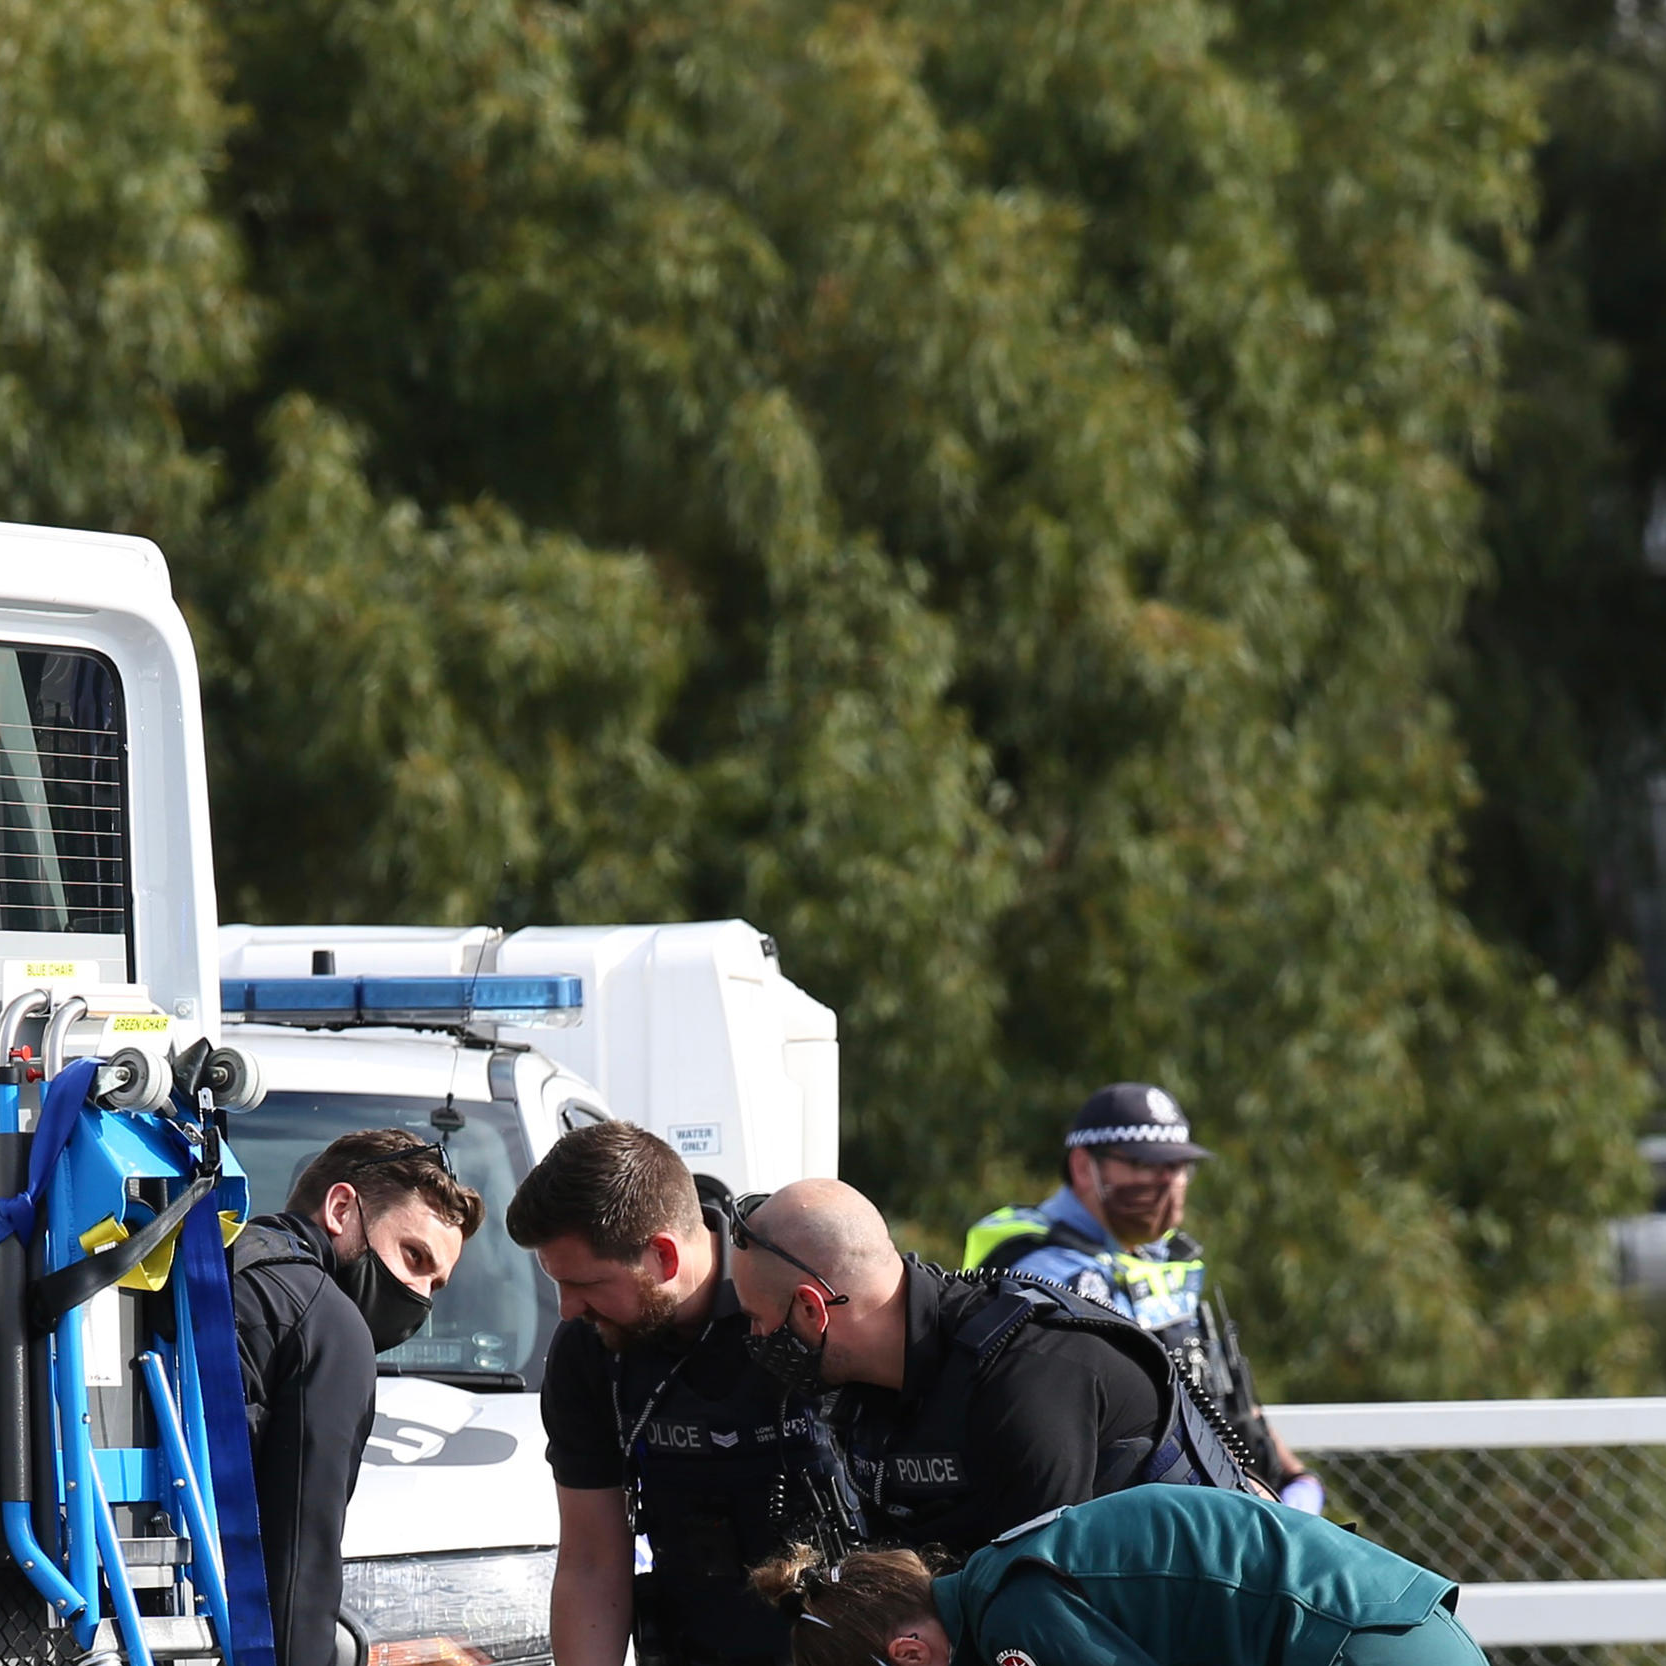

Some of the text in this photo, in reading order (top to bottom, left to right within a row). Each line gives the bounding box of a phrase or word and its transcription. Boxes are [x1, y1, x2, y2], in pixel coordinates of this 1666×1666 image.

[113, 1017, 169, 1031] GREEN CHAIR
[675, 1127, 713, 1139] WATER
[680, 1141, 709, 1152] ONLY
[646, 1421, 702, 1448] OLICE
[895, 1457, 959, 1483] POLICE
